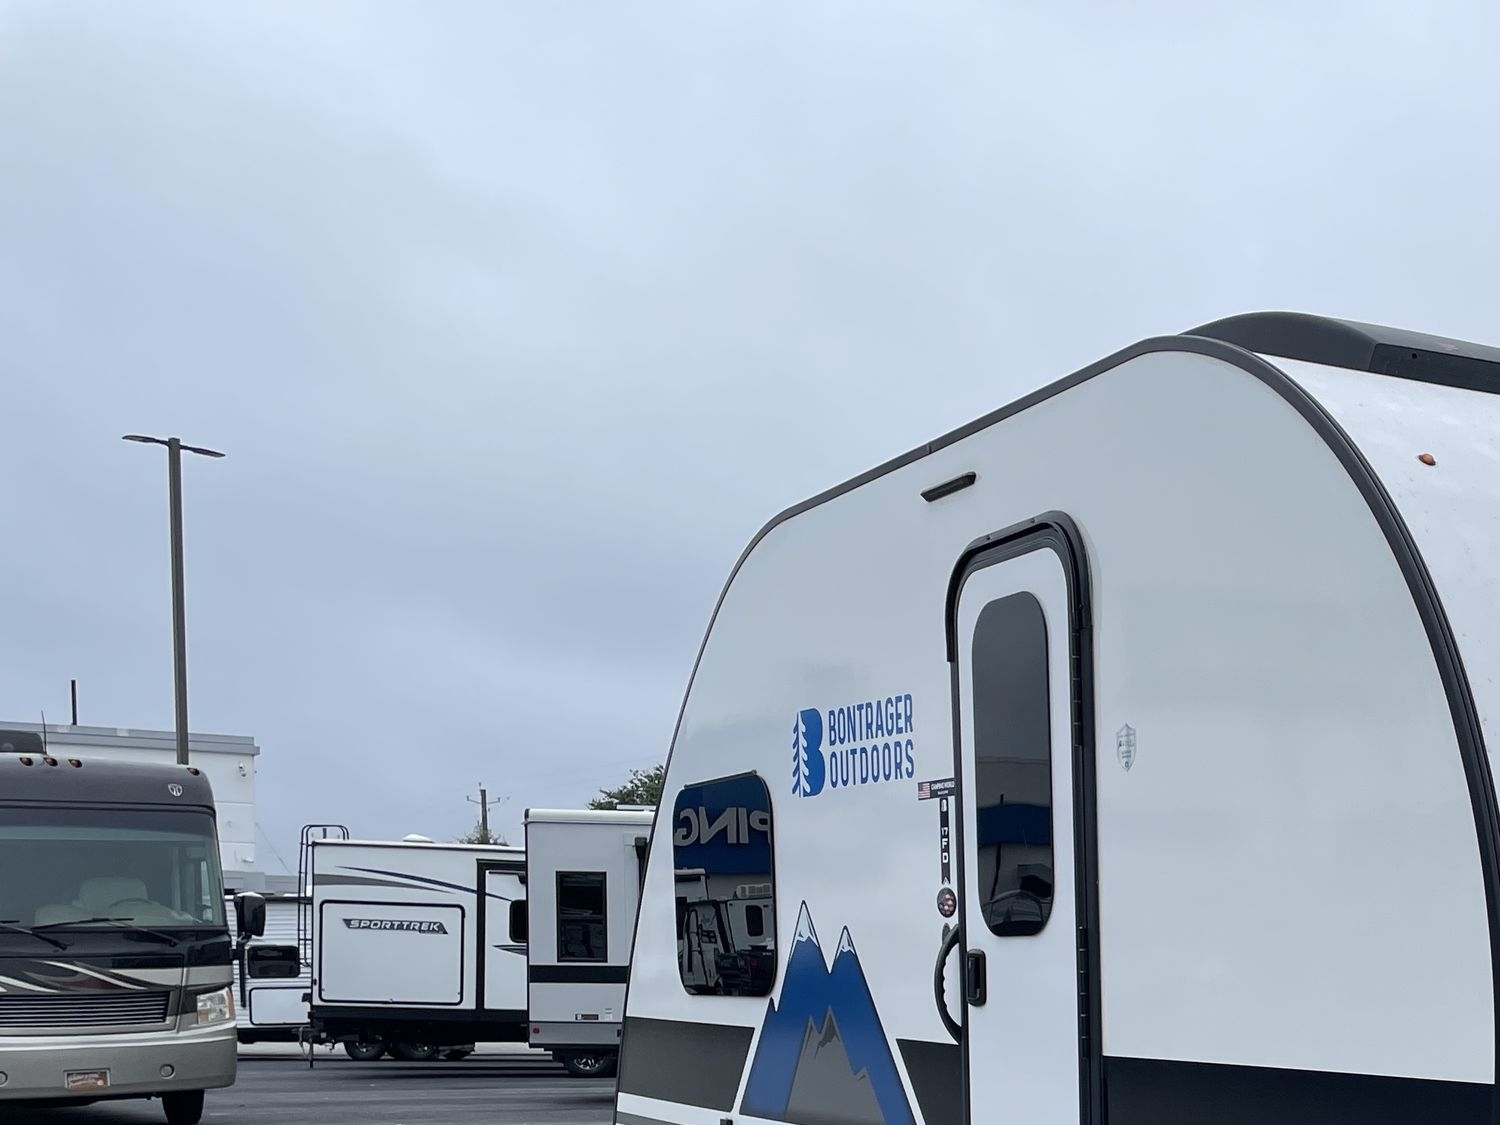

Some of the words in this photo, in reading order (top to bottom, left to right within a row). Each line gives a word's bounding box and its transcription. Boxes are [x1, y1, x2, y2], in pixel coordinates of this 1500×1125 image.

[828, 694, 913, 746] BONTRAGER
[830, 739, 914, 788] OUTDOORS
[349, 920, 440, 931] SPORTTREK
